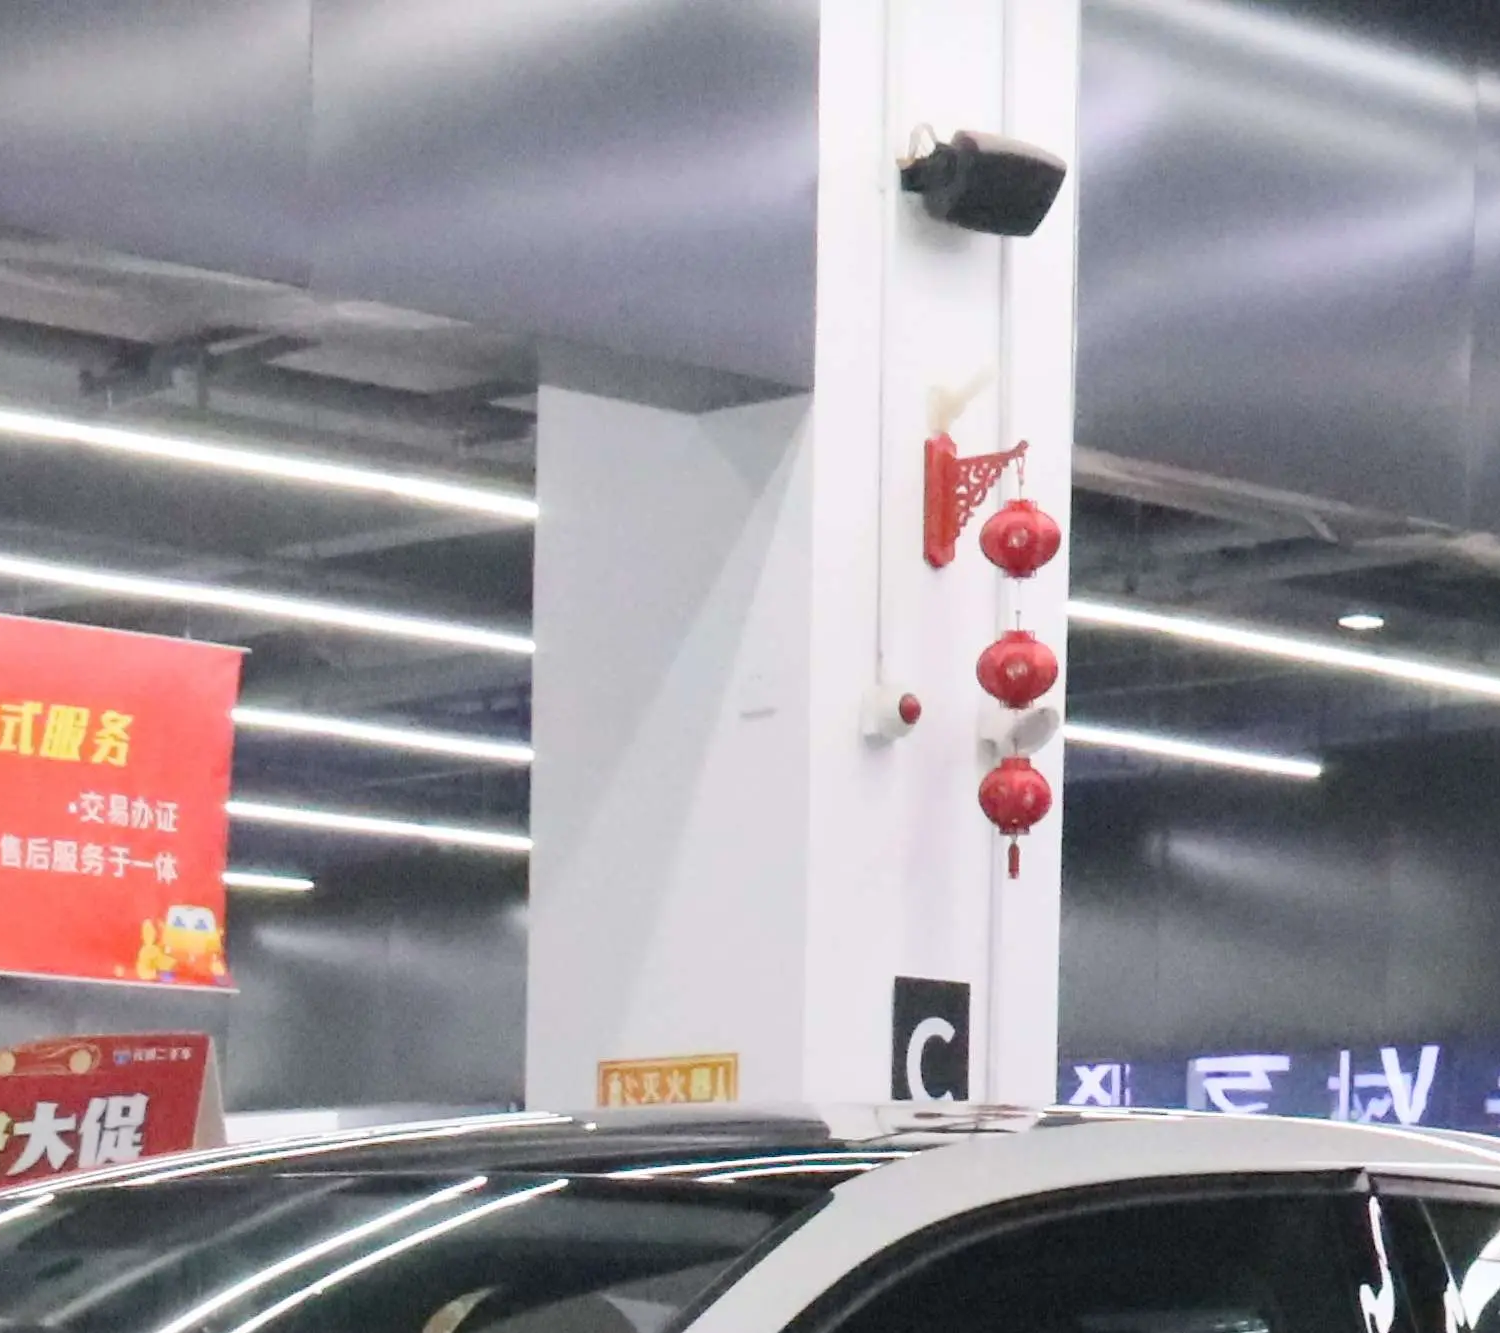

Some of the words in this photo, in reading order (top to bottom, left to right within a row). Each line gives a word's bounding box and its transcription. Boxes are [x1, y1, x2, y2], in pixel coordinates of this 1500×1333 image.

[79, 791, 179, 833] 交易办证
[906, 1016, 956, 1101] C
